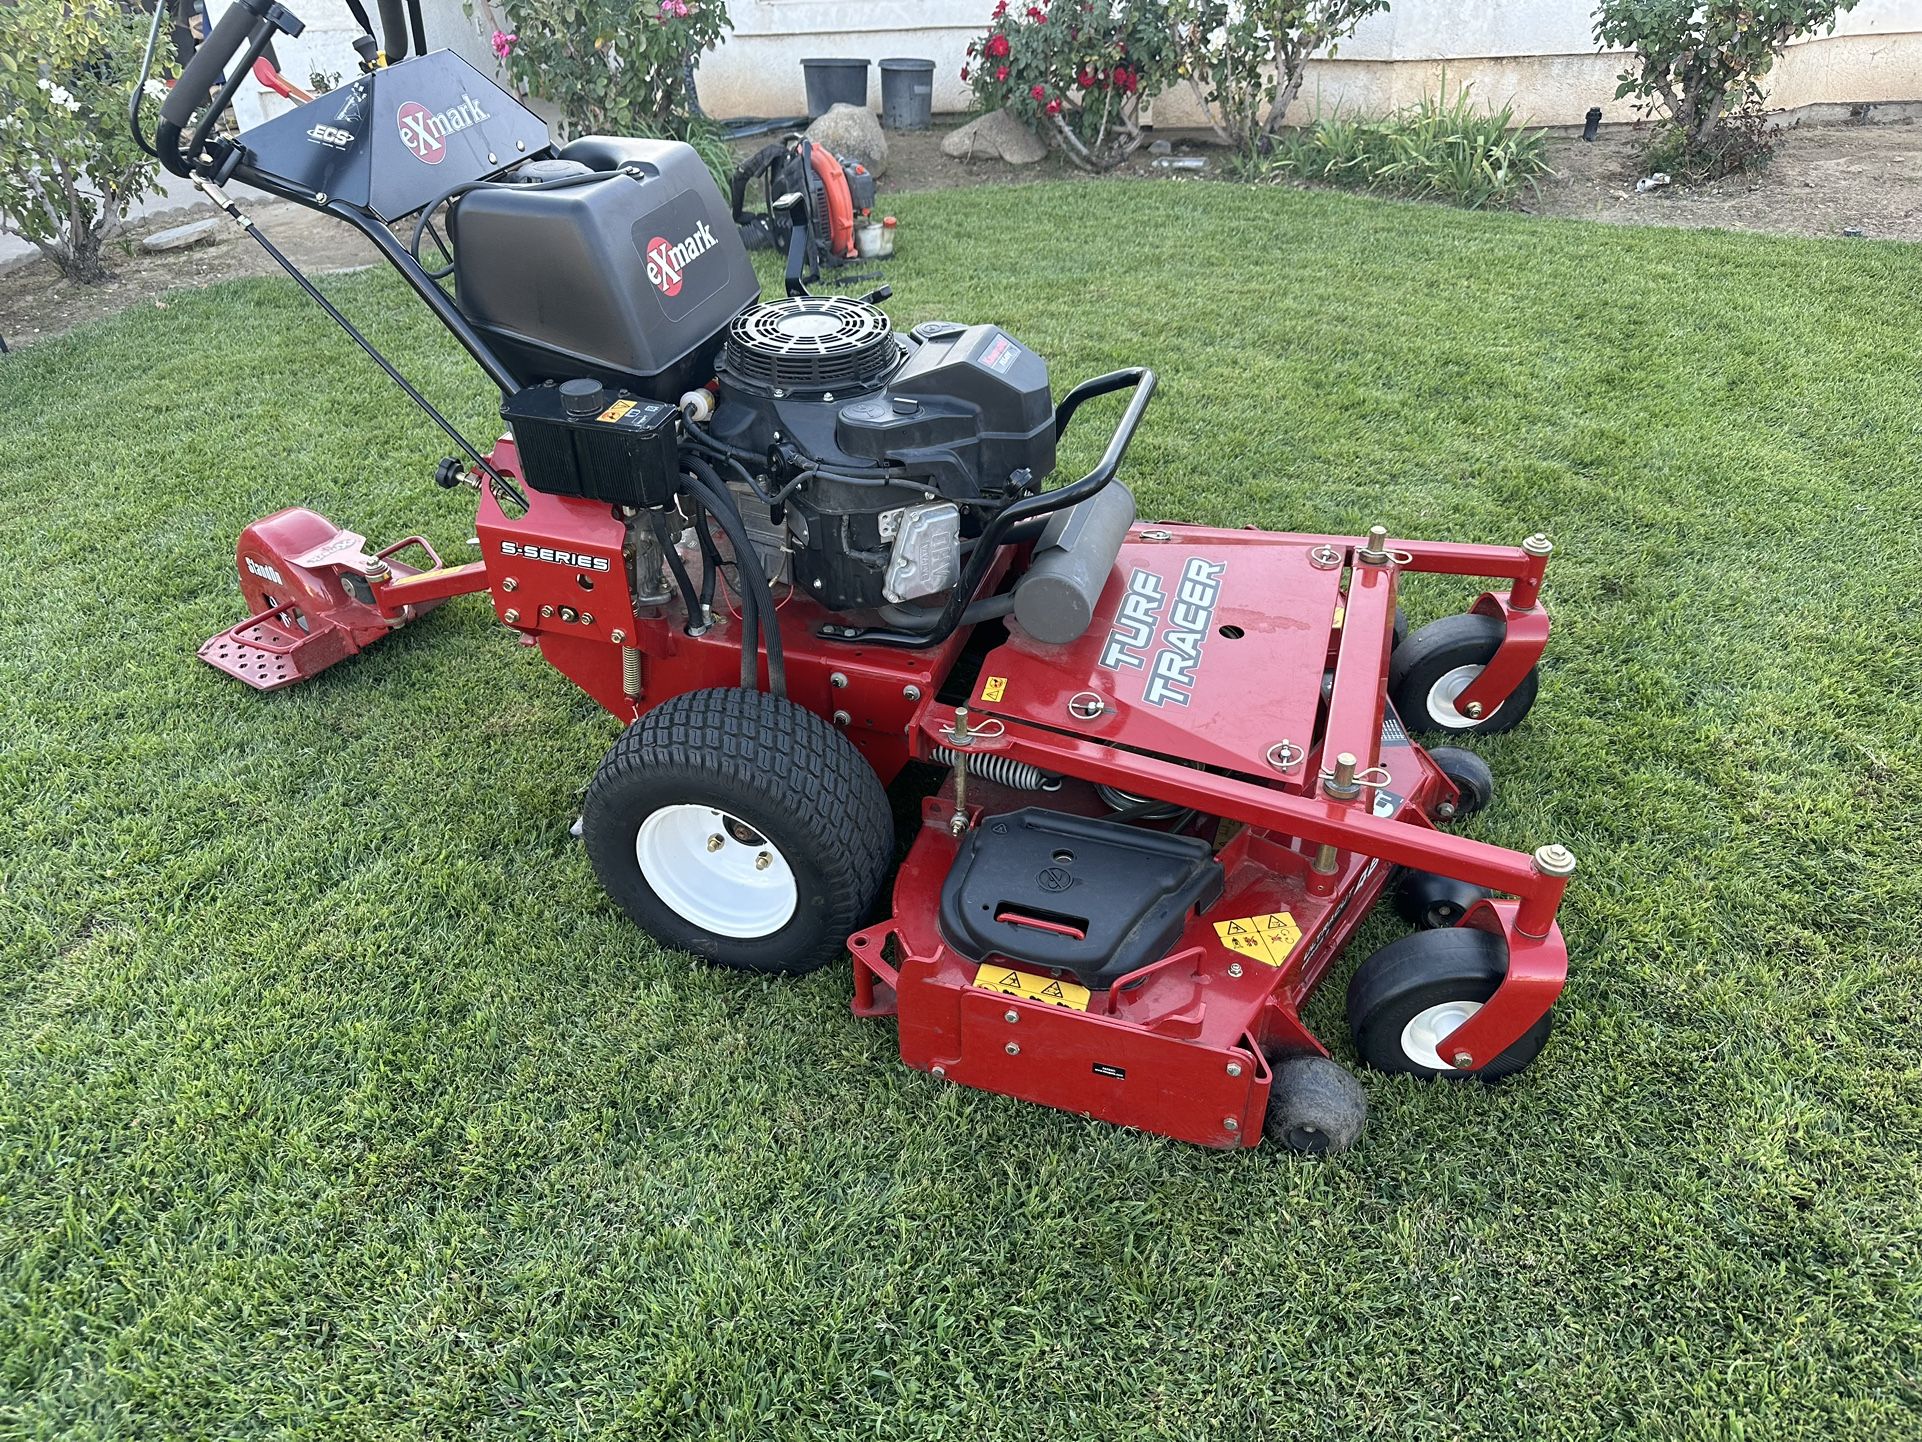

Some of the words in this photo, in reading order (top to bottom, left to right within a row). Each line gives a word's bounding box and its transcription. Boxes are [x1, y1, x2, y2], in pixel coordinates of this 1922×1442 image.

[313, 123, 350, 146] ECS
[501, 540, 609, 571] S-SERIES
[1101, 569, 1166, 669] TURF
[1144, 557, 1225, 705] TRACER
